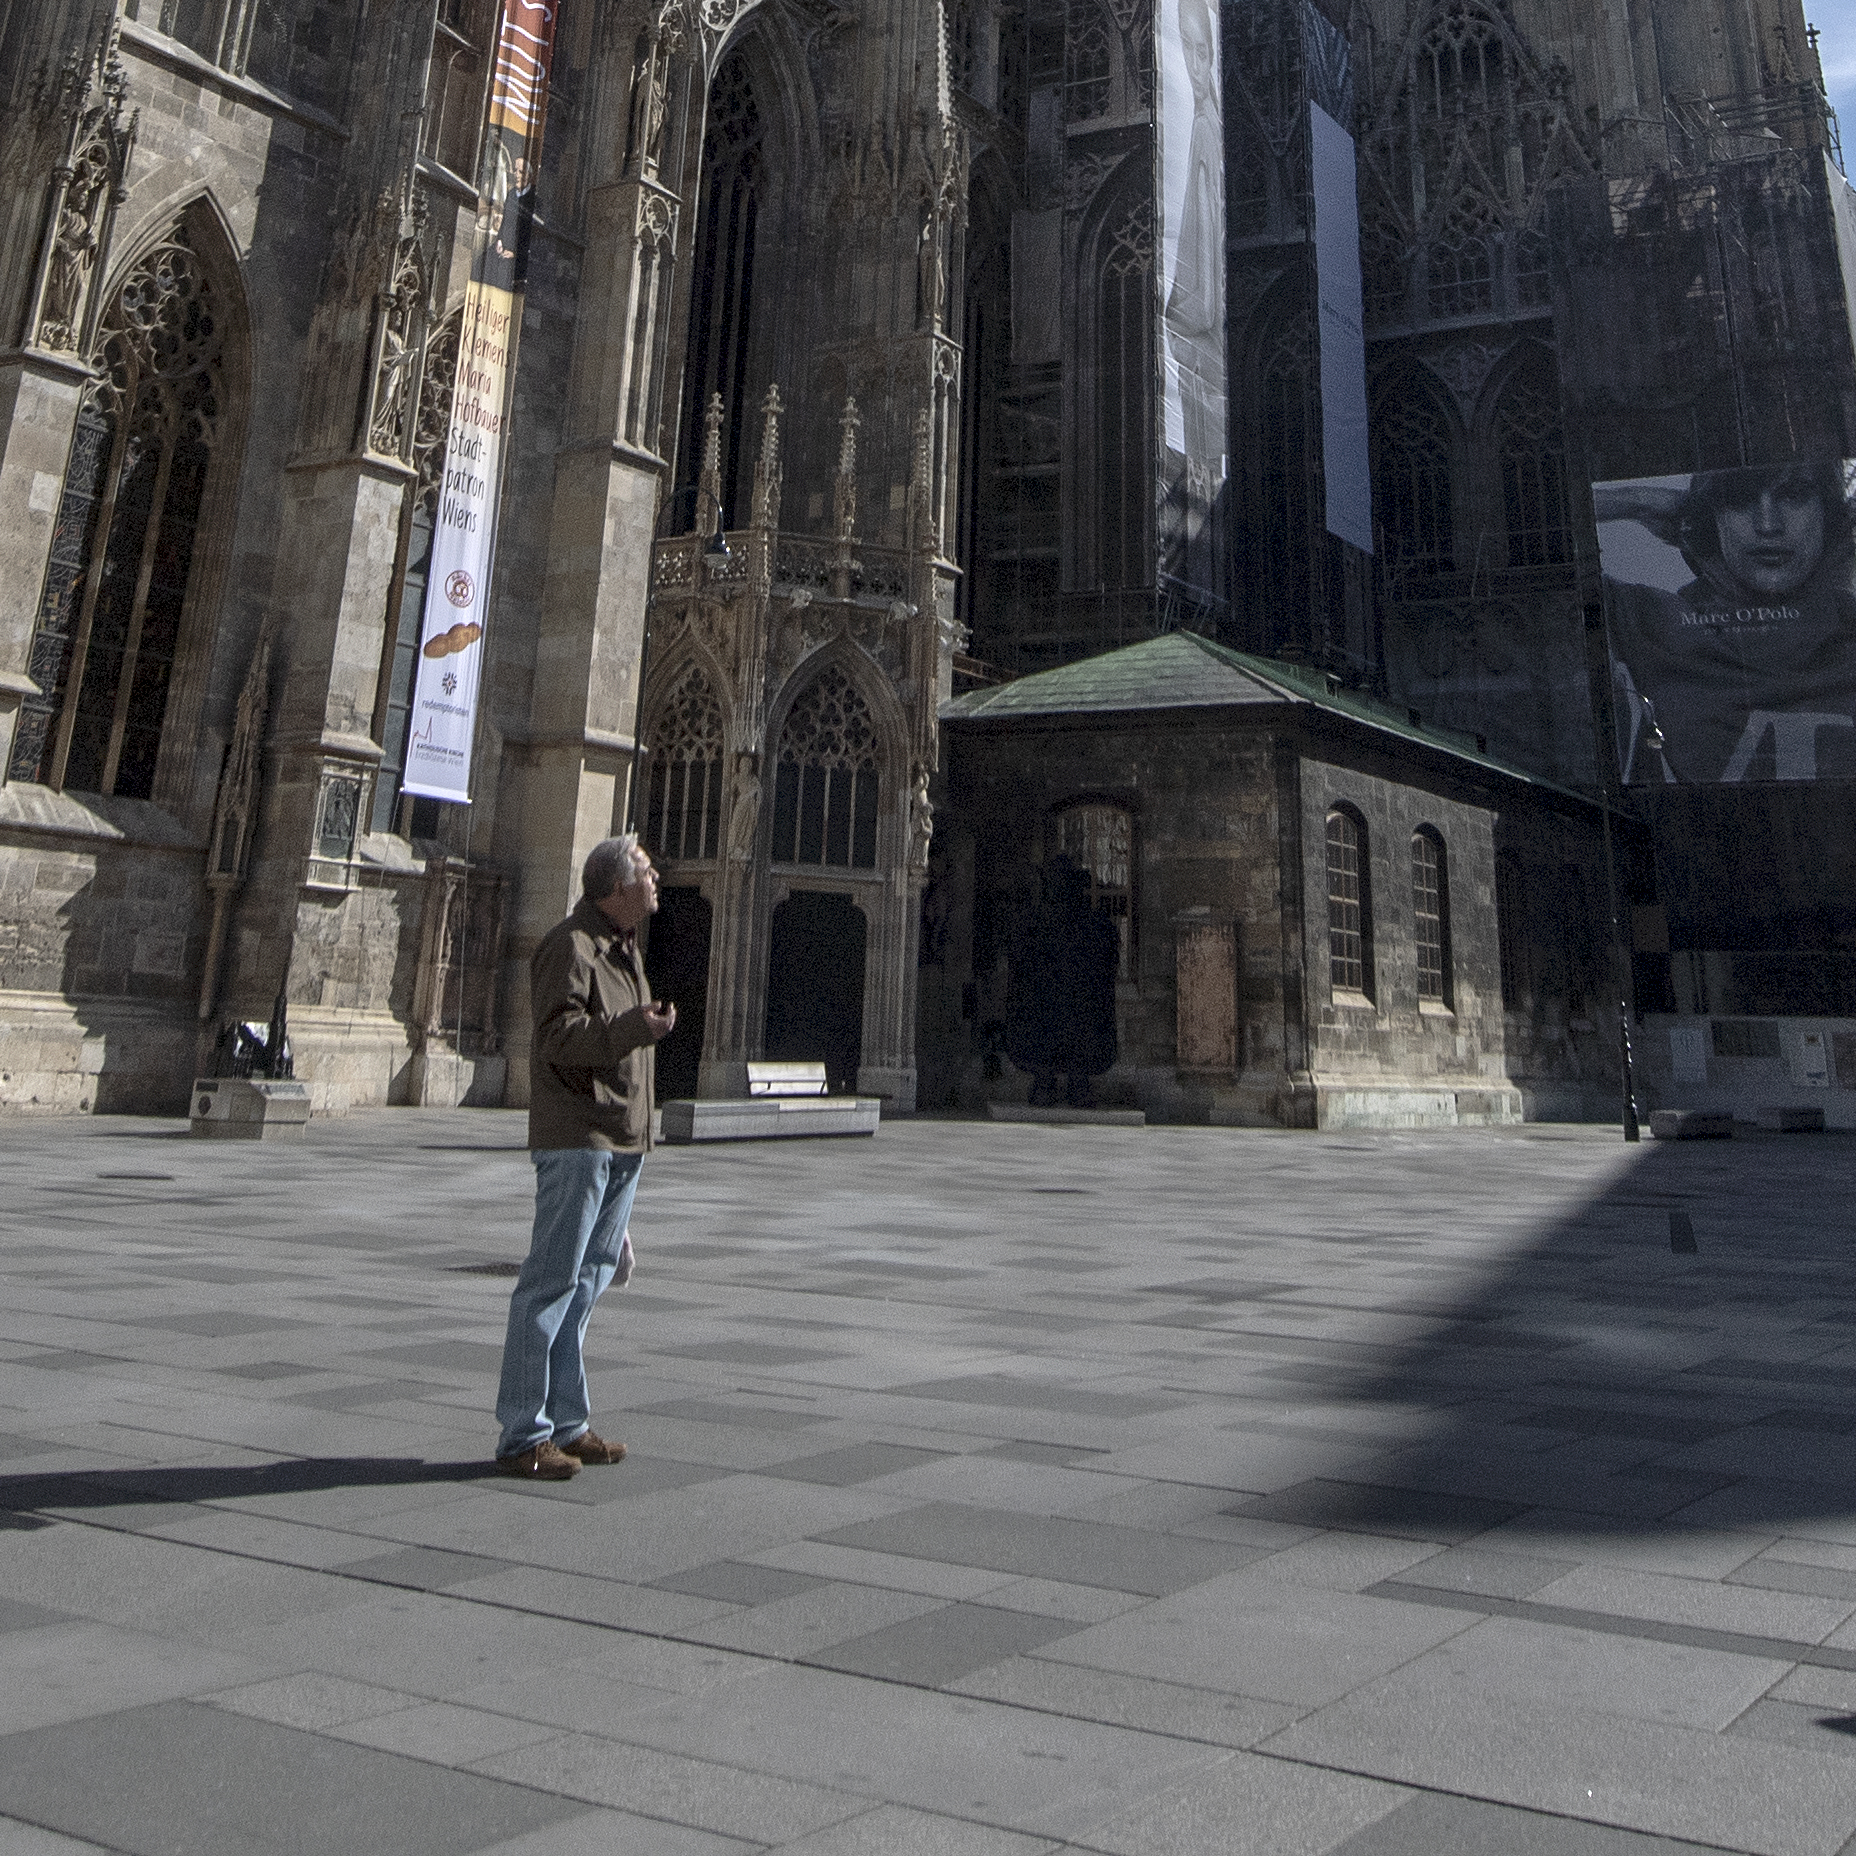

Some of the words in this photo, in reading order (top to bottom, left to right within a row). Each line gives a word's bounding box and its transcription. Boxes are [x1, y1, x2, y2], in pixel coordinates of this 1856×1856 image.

[492, 9, 549, 125] MUT
[466, 292, 510, 336] Heiliger
[462, 324, 512, 369] Klemens
[458, 357, 492, 395] Maria
[454, 392, 507, 435] Hofbauer
[449, 426, 487, 463] Stadt-
[445, 467, 485, 500] patron
[442, 495, 478, 533] Wiens
[1679, 611, 1730, 625] Marc
[1735, 605, 1801, 623] O'Polo
